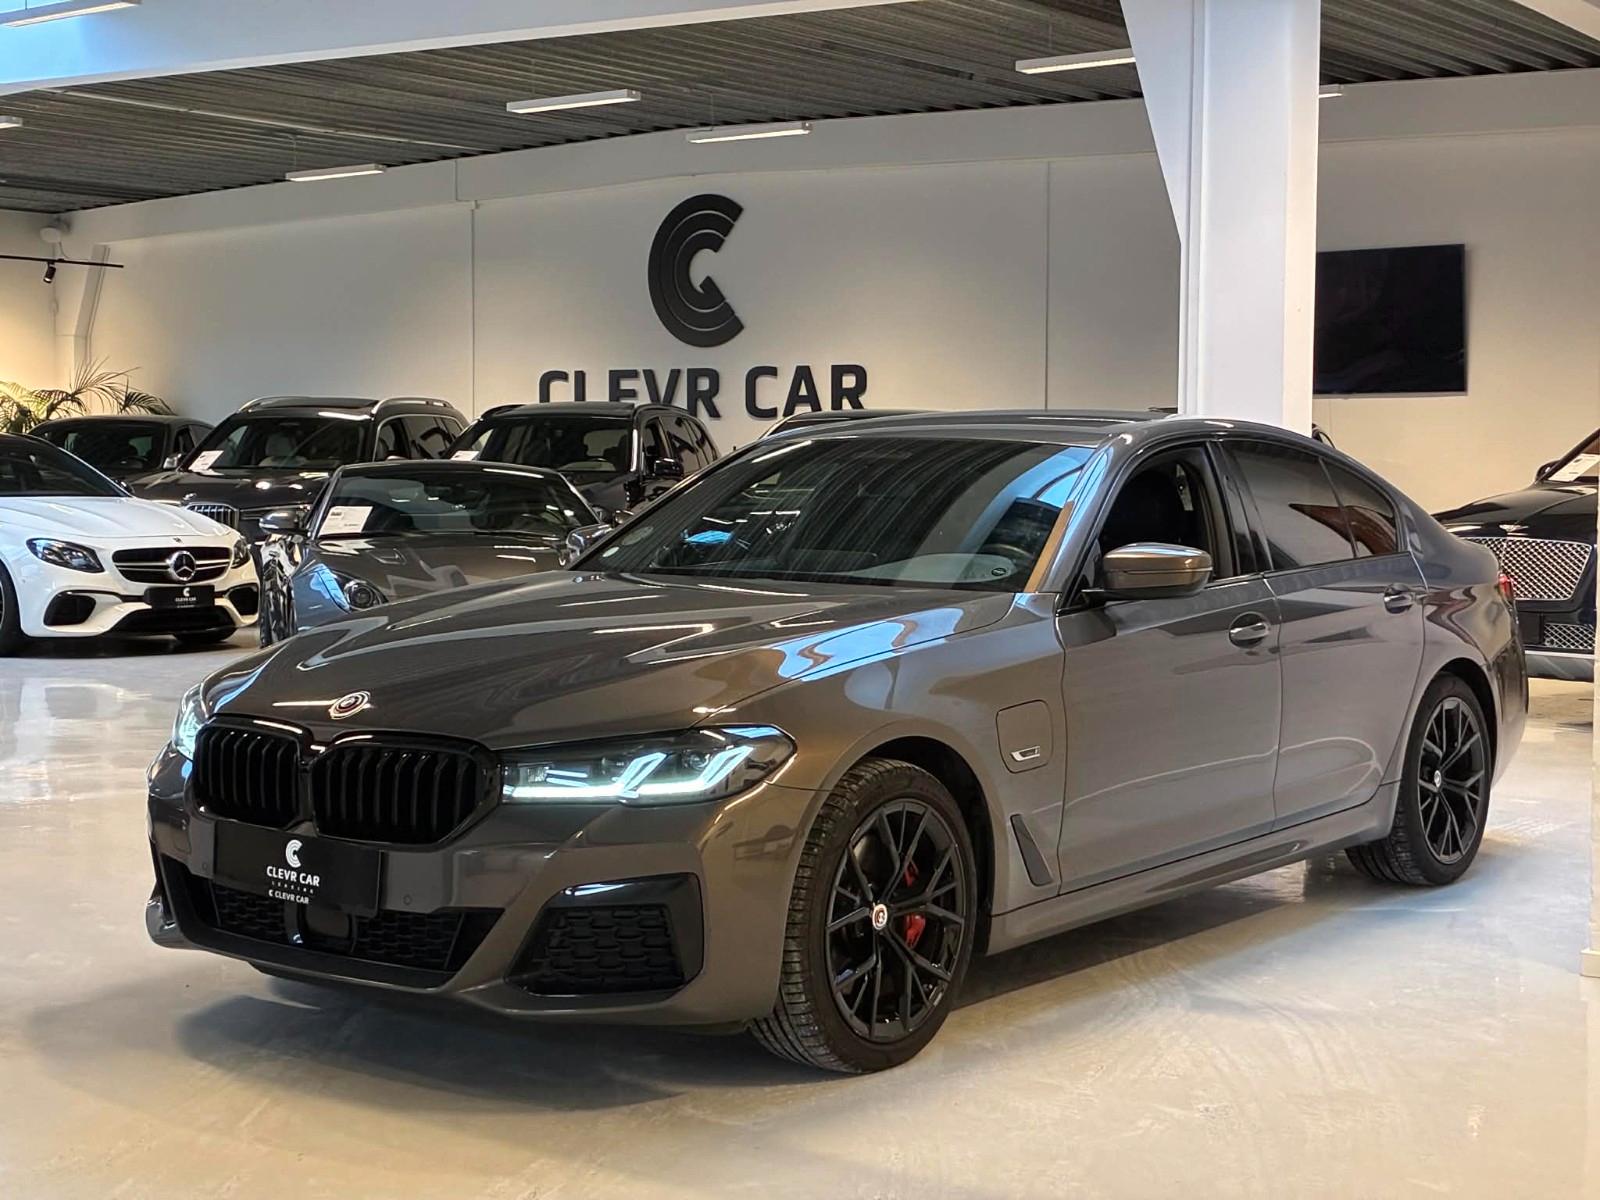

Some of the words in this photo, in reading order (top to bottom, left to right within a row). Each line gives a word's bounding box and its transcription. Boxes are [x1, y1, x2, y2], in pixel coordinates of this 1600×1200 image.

[745, 364, 868, 420] CAR
[266, 866, 297, 881] CLEVR
[299, 873, 320, 887] CAR
